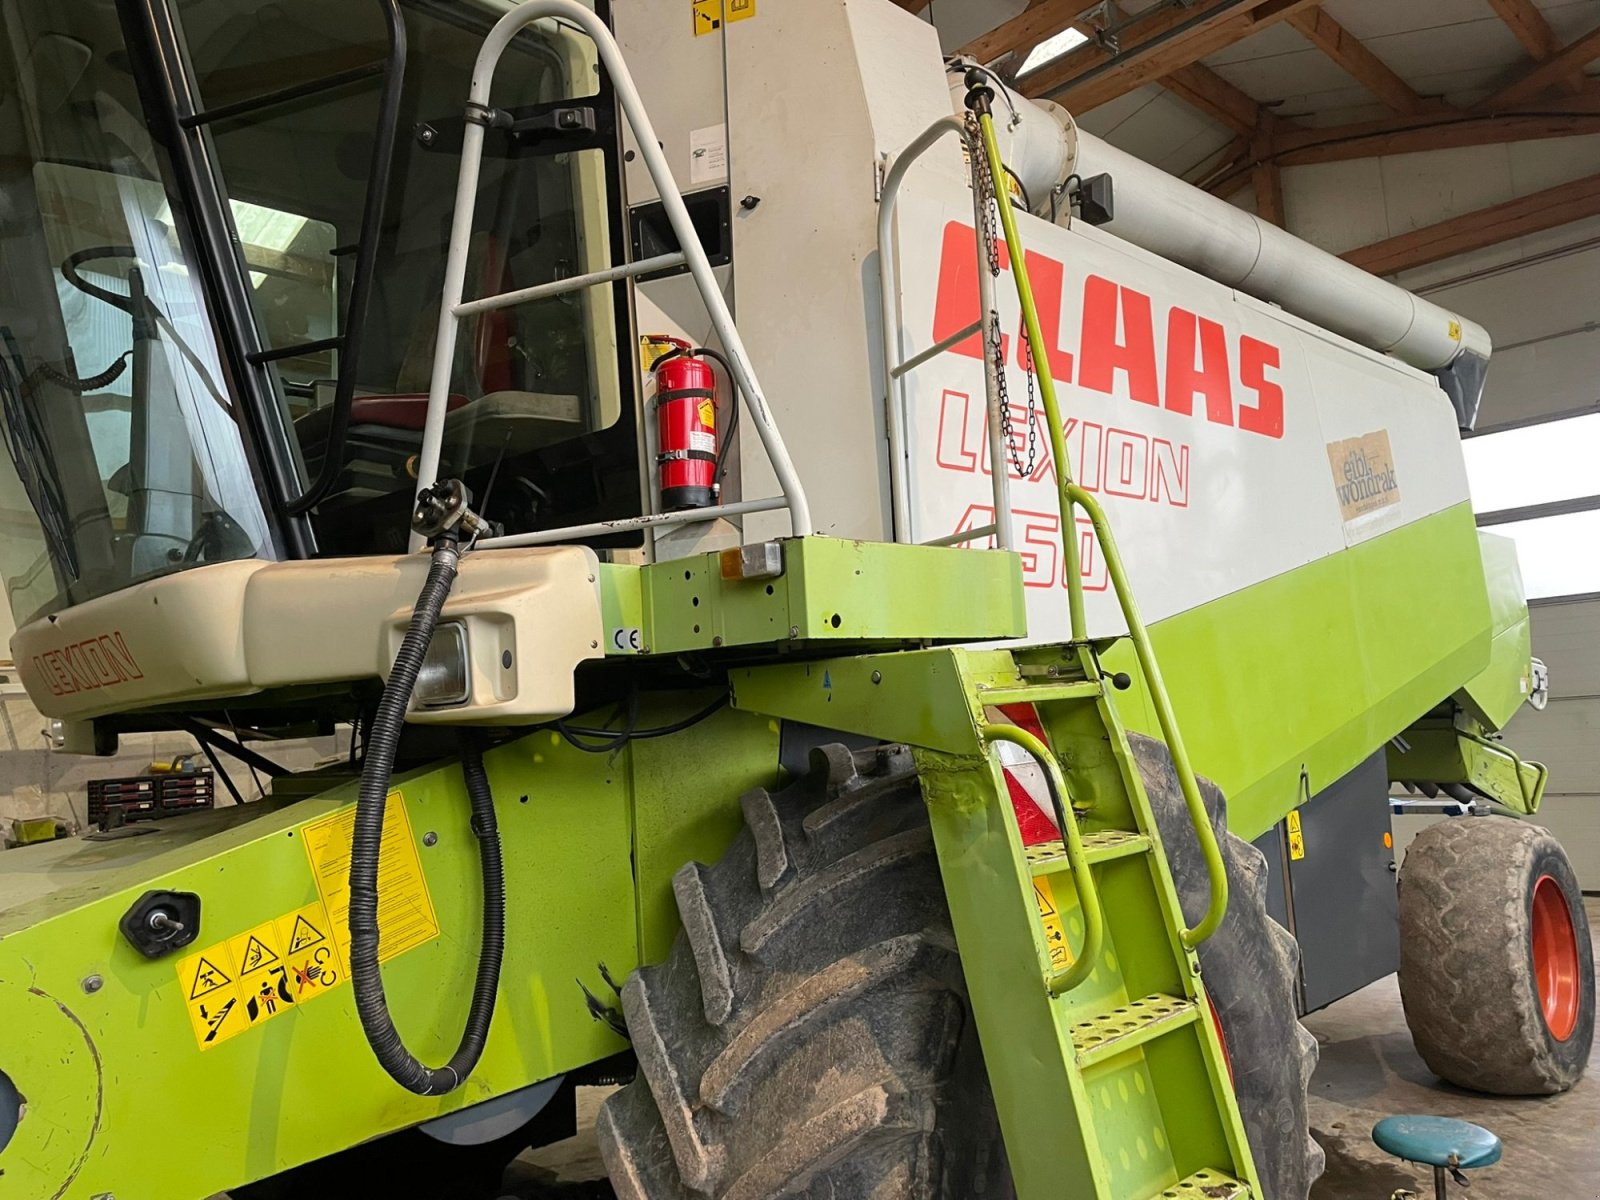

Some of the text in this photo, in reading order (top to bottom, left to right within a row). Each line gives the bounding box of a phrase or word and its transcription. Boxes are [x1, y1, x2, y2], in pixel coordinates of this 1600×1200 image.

[933, 220, 1285, 439] CLAAS
[936, 389, 1189, 508] LEXION
[1336, 463, 1398, 506] wondrak
[33, 631, 144, 696] LEXION
